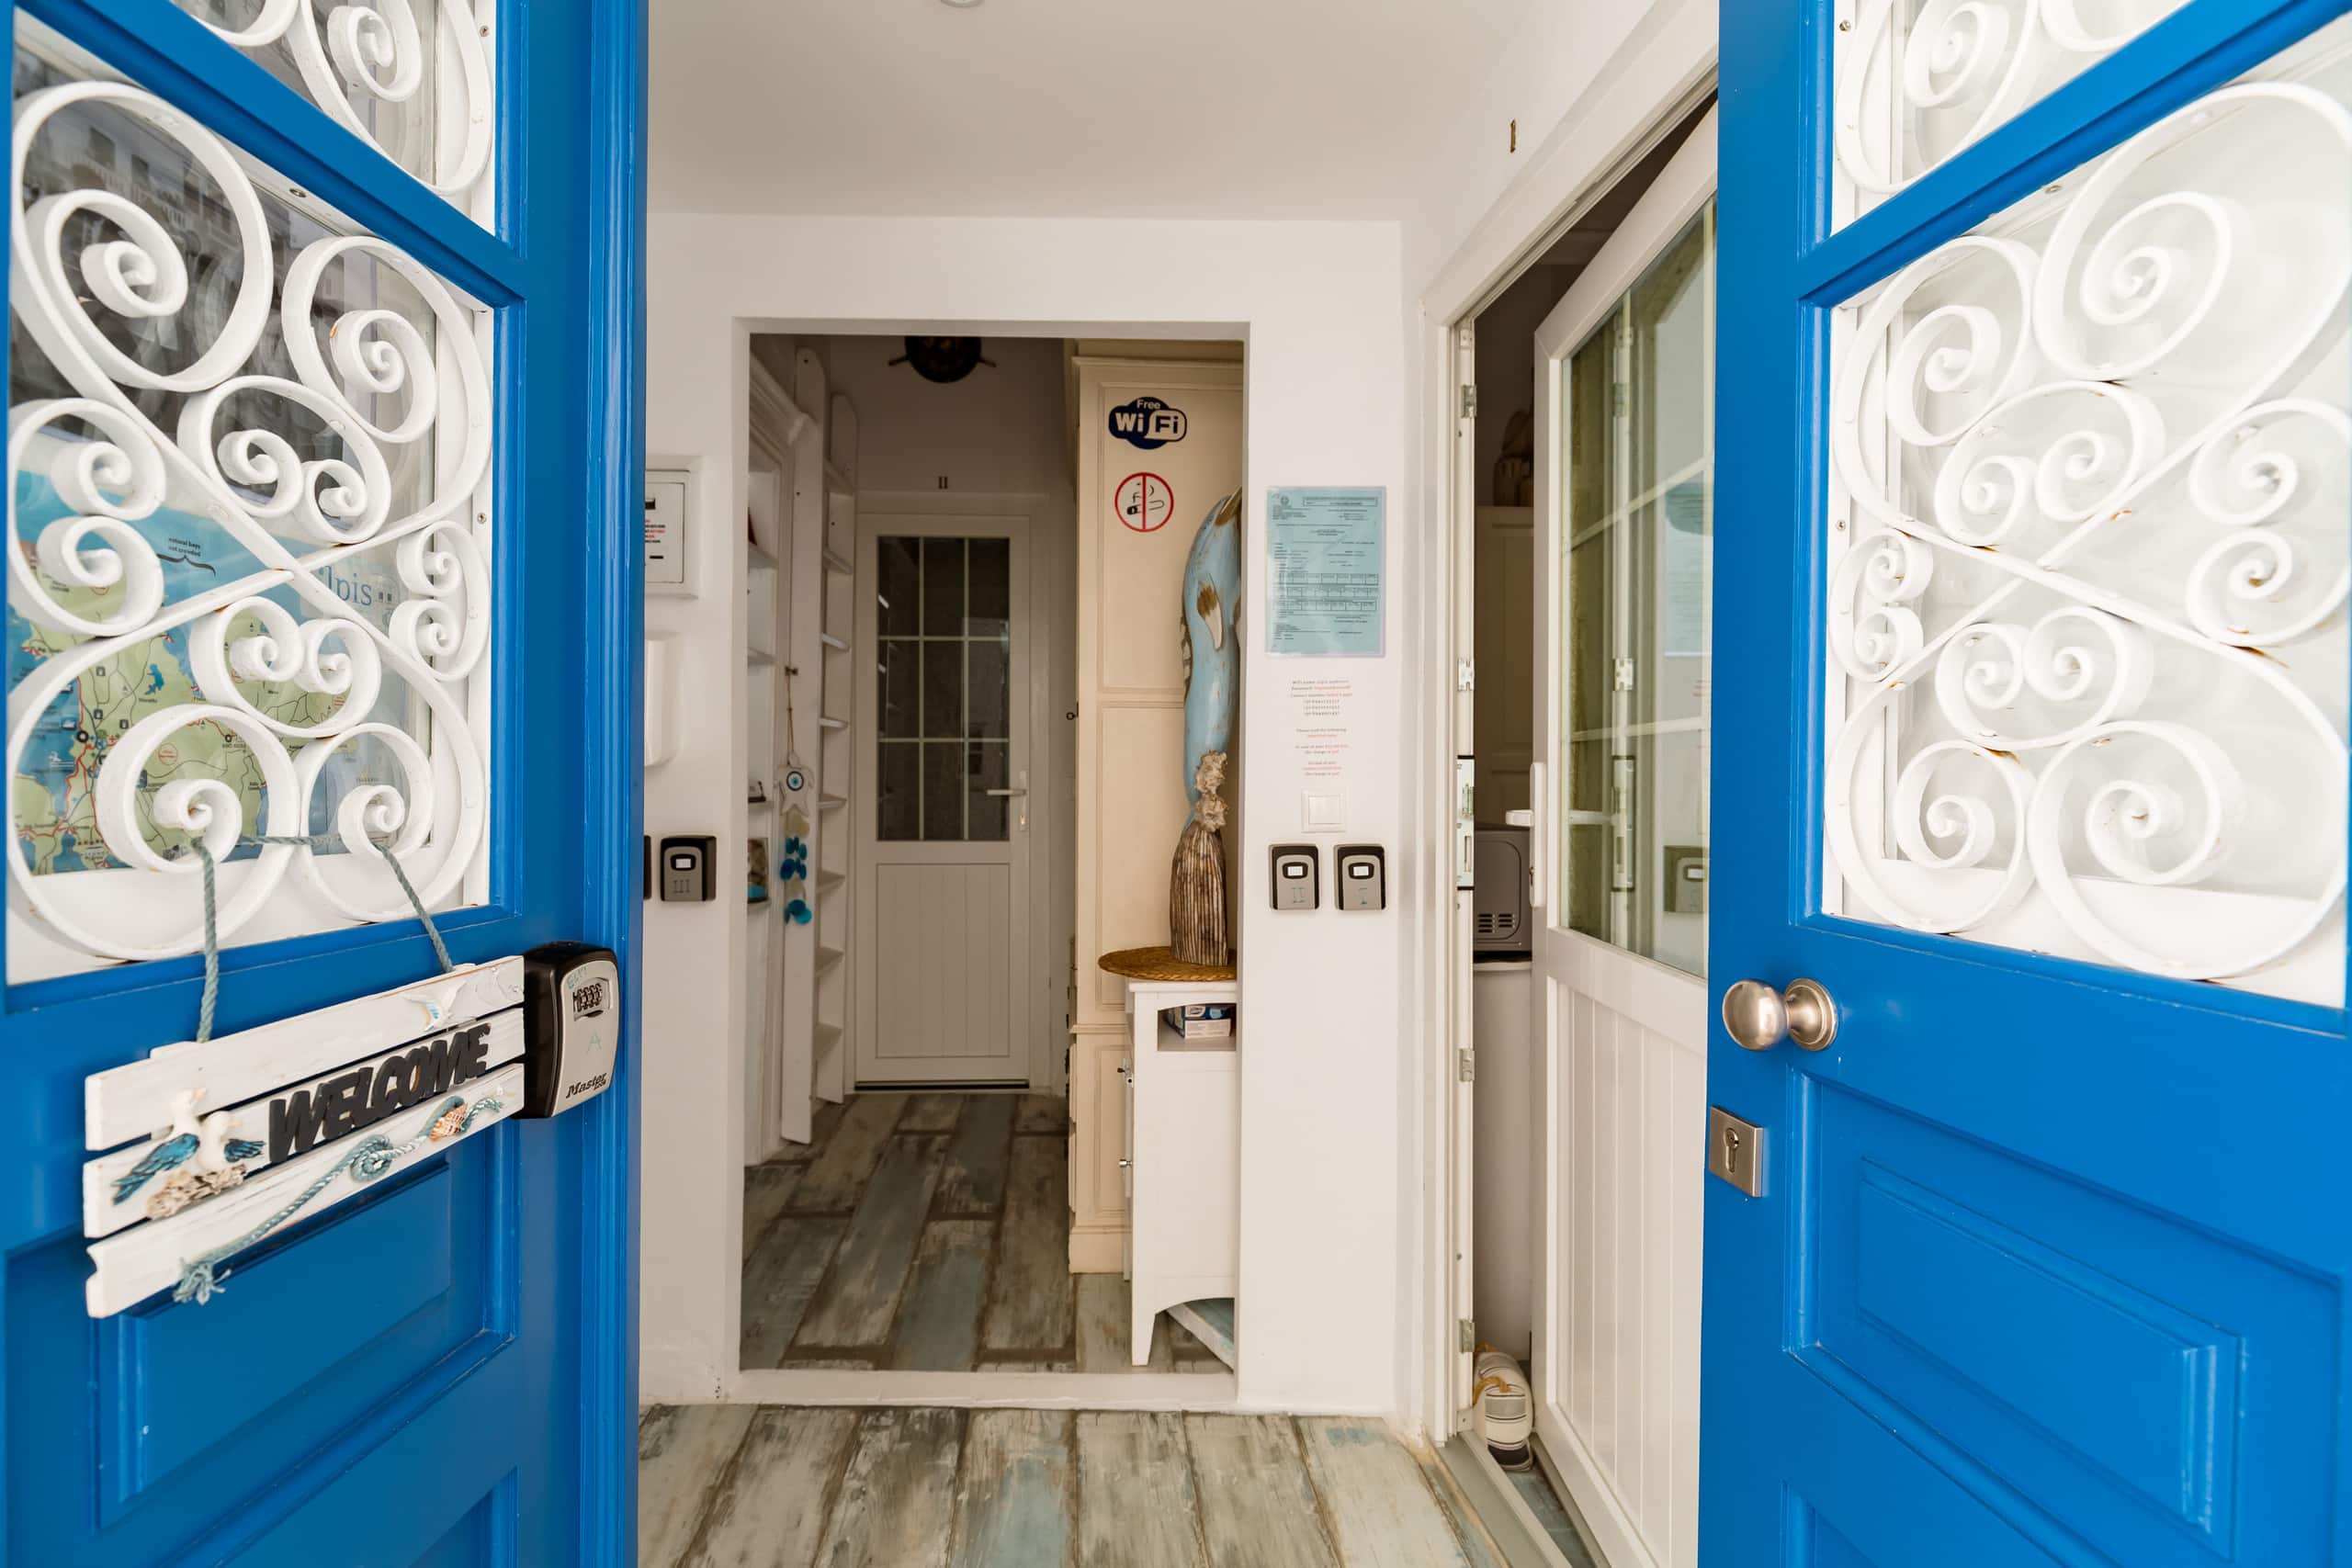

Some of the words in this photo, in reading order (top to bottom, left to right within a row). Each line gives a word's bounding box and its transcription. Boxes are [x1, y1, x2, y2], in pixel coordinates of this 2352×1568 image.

[1136, 400, 1161, 410] Free
[269, 1022, 492, 1164] WELCOME
[565, 1072, 607, 1100] Master
